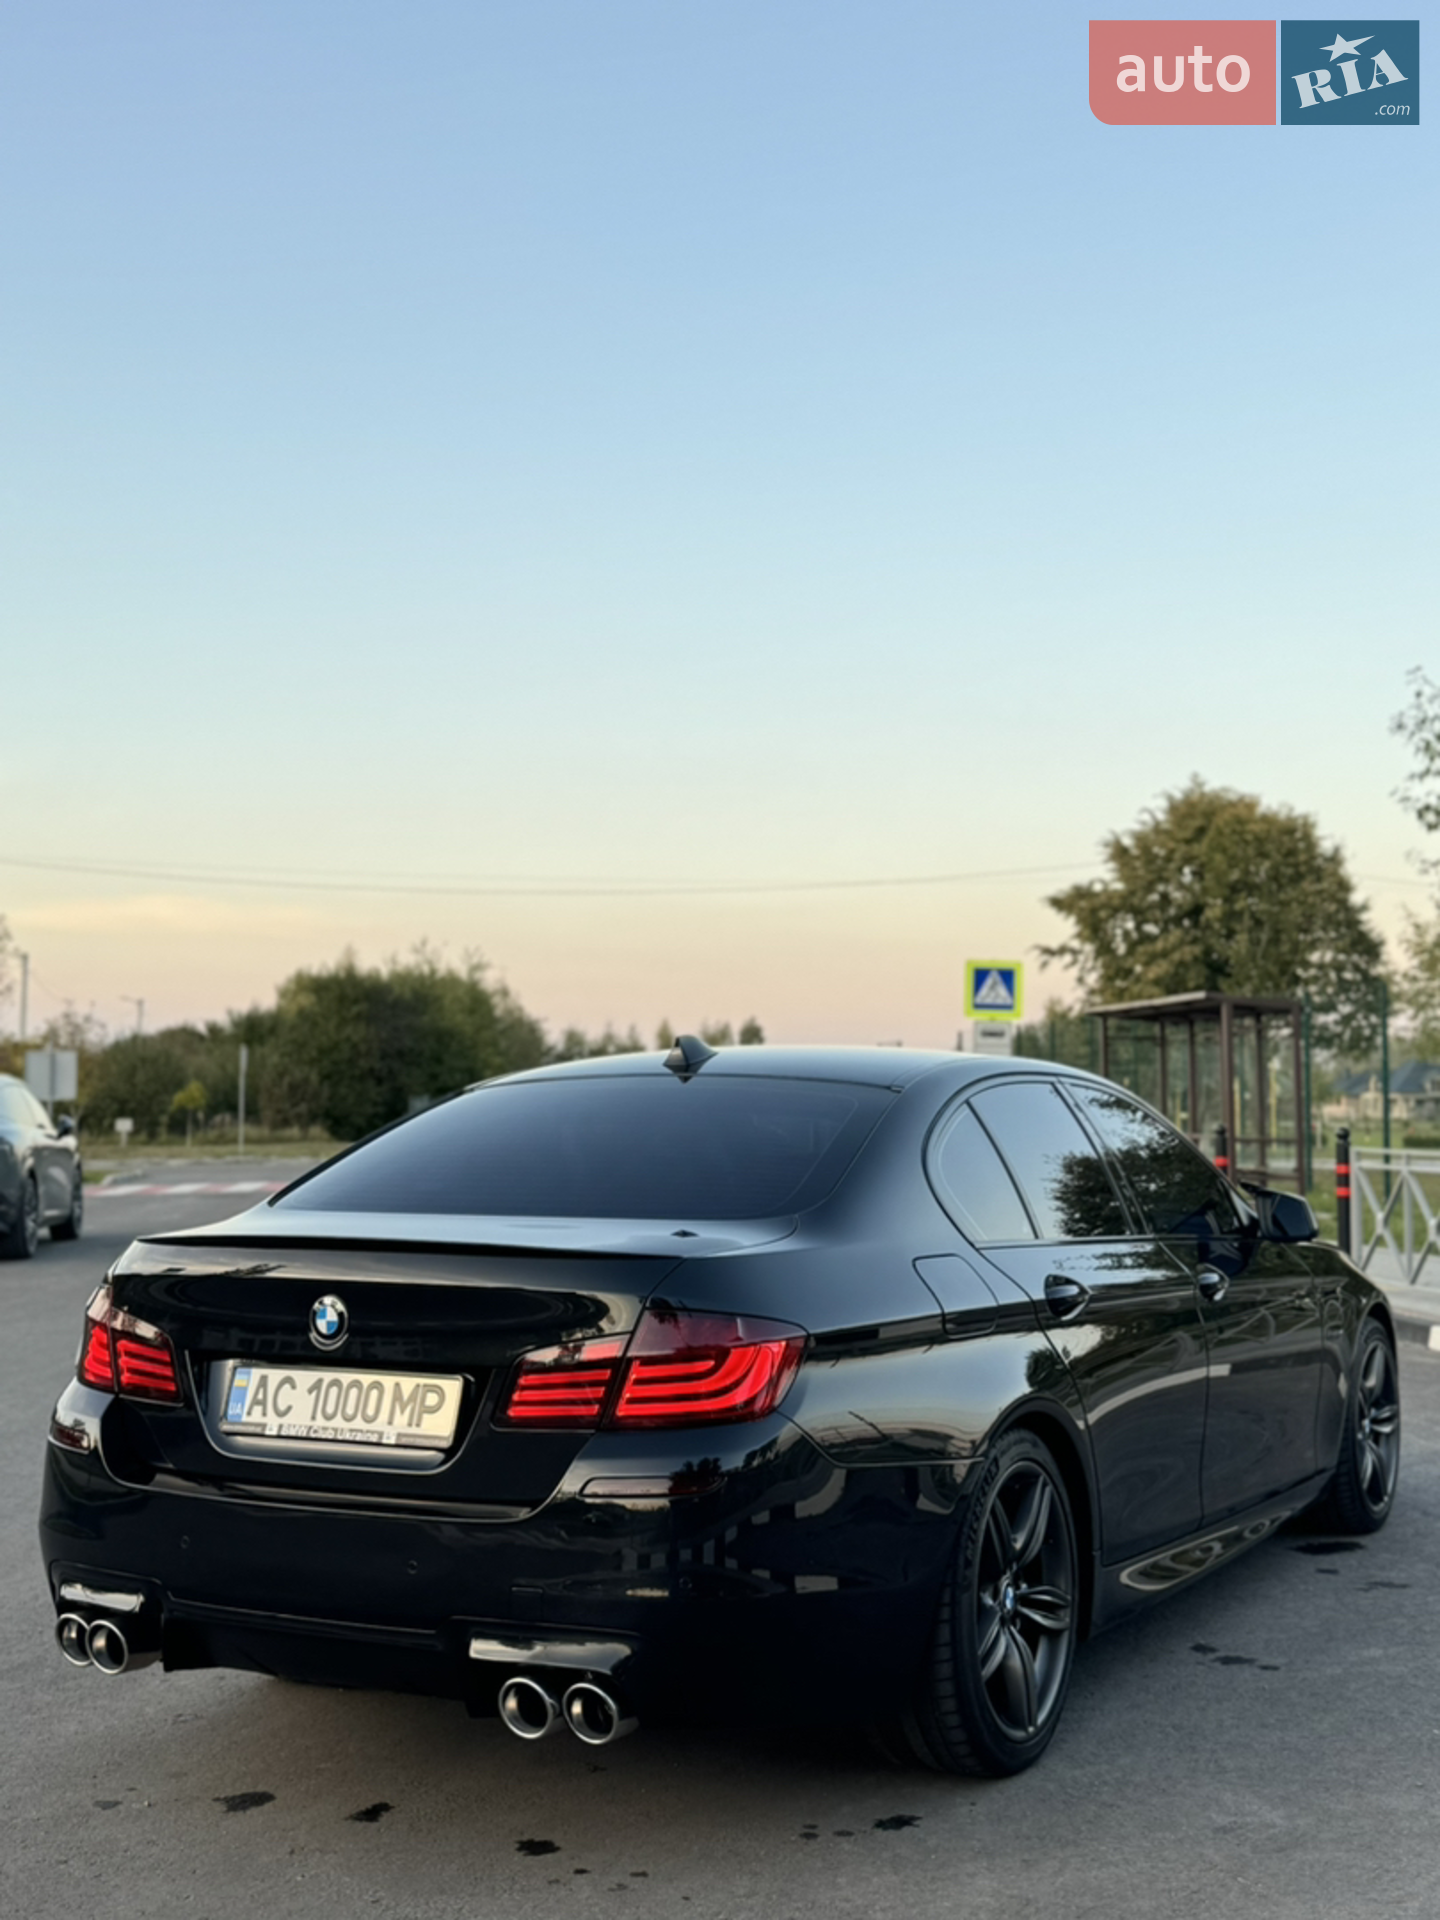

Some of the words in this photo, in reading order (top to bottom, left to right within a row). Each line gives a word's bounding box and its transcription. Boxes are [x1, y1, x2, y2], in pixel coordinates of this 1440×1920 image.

[229, 1402, 243, 1416] UA
[246, 1374, 297, 1418] AC
[307, 1377, 385, 1424] 1000
[387, 1382, 446, 1428] MP
[281, 1424, 307, 1437] BMW
[309, 1426, 335, 1439] Club
[336, 1427, 379, 1442] Ukraine
